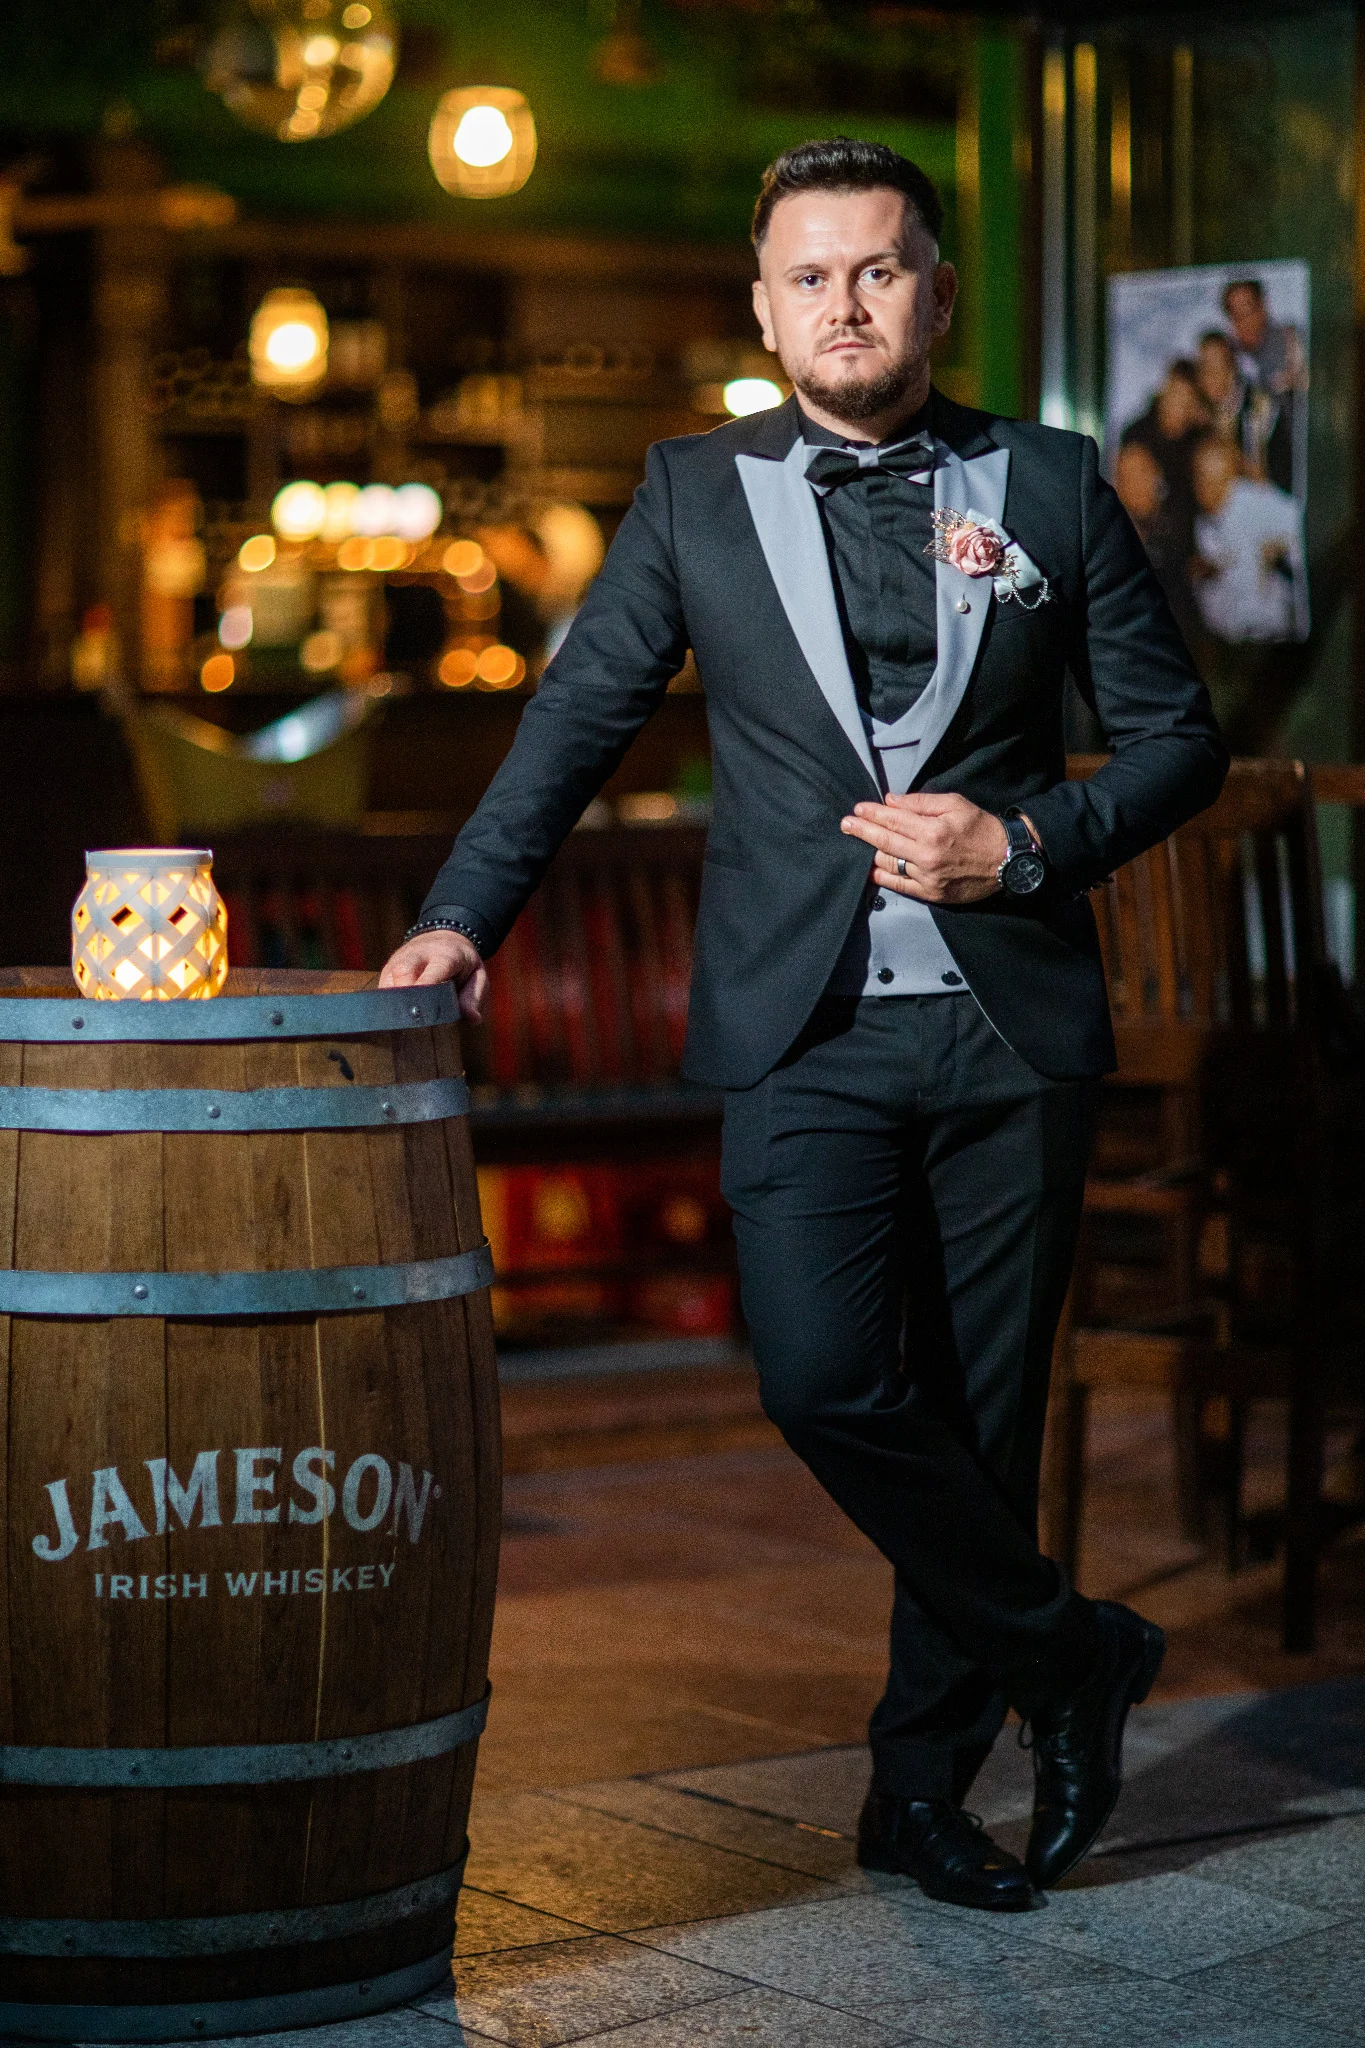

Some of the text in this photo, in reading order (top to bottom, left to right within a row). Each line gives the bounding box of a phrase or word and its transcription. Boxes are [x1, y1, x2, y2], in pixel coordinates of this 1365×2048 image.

[31, 1446, 434, 1561] JAMESON
[94, 1563, 396, 1599] IRISH WHISKEY
